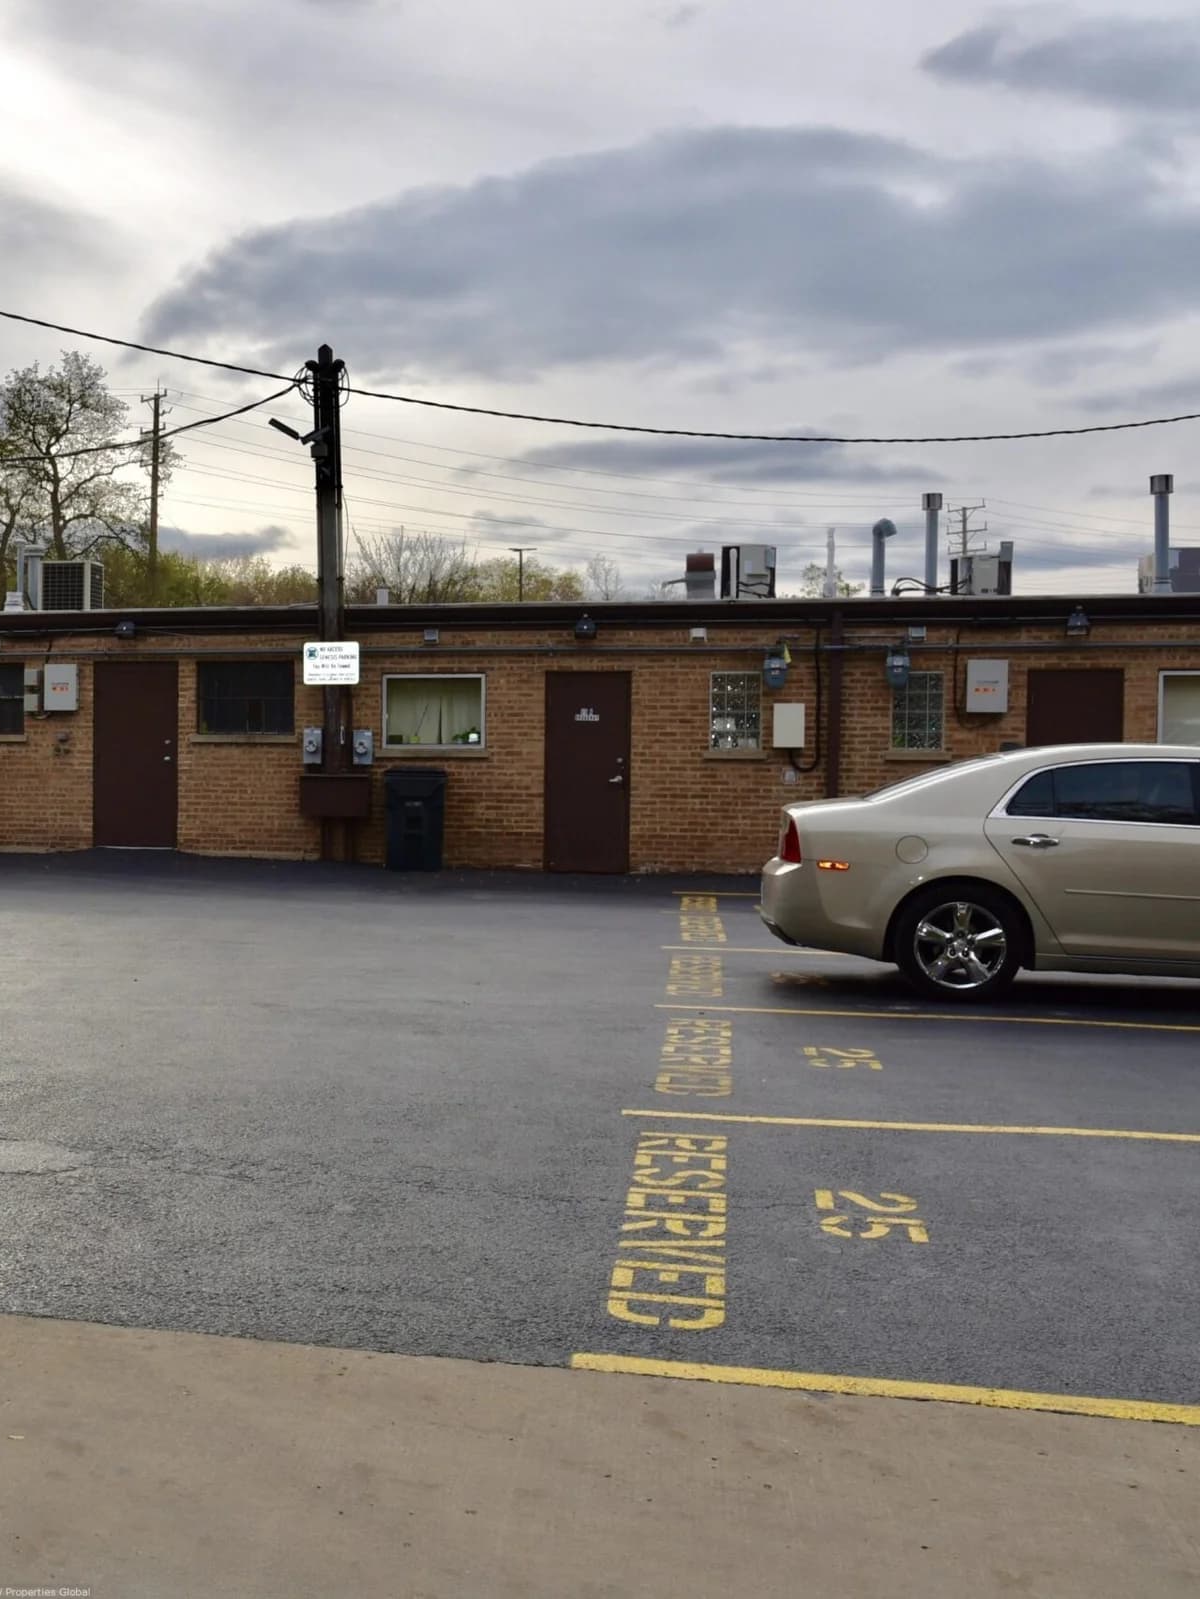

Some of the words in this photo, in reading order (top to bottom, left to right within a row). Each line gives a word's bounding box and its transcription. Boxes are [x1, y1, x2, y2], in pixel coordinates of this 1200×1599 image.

[655, 1018, 732, 1097] RESERVED
[802, 1047, 883, 1070] 25
[607, 1131, 728, 1330] RESERVED
[814, 1188, 929, 1243] 25
